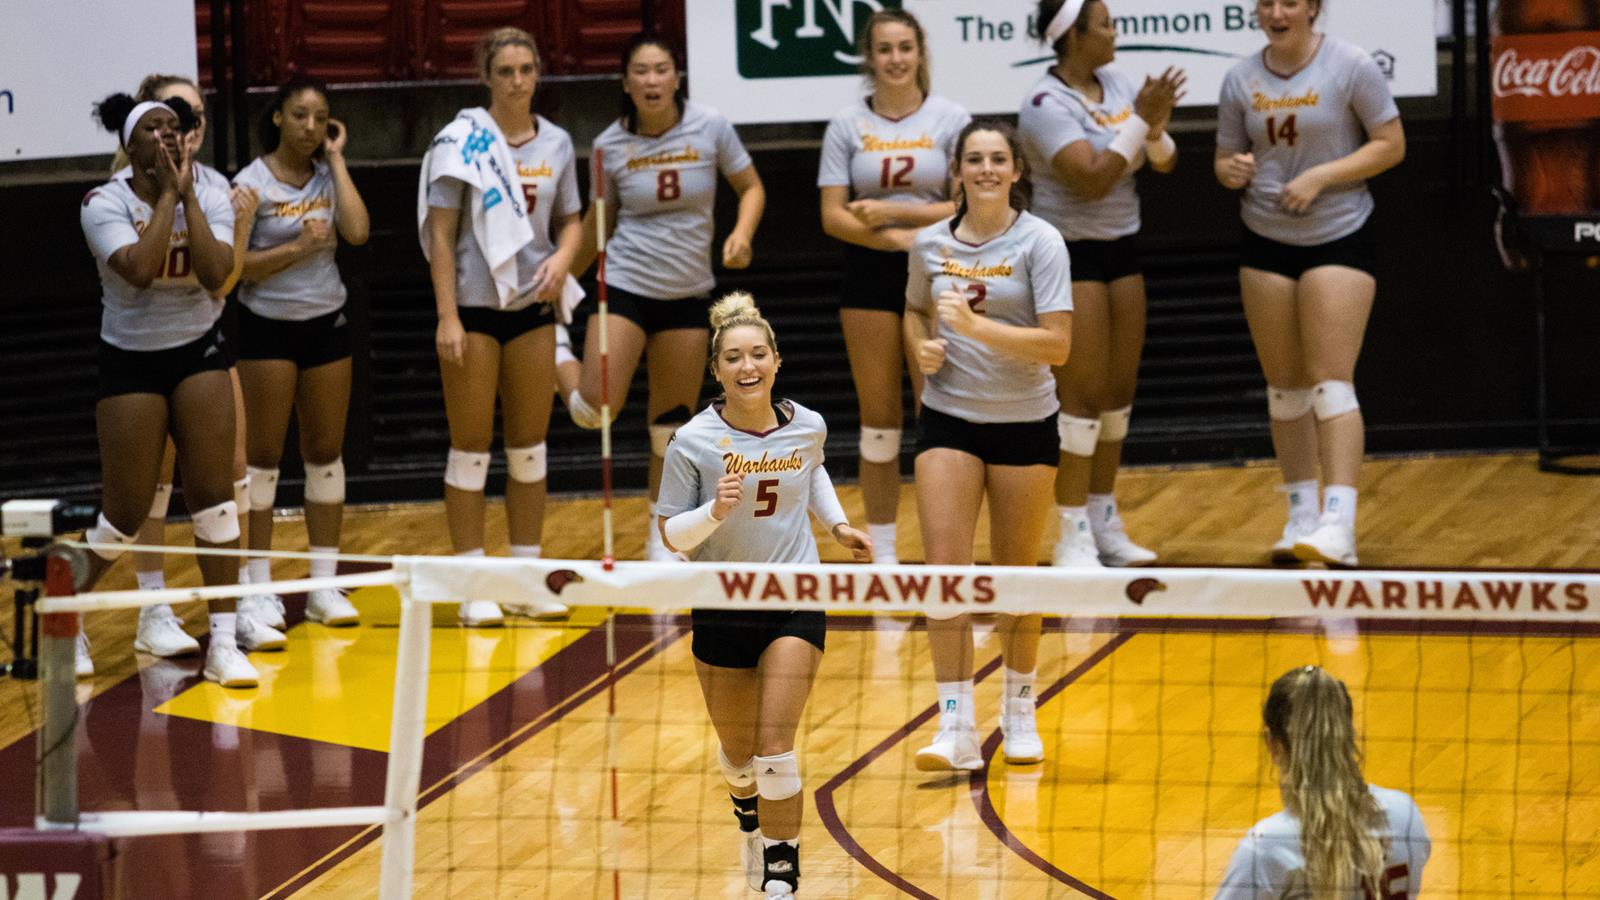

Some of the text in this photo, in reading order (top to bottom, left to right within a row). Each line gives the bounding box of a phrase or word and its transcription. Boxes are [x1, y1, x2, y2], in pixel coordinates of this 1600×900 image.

[955, 16, 1013, 41] The
[1492, 46, 1600, 97] Coca-Col
[1266, 114, 1298, 146] 14
[657, 169, 680, 201] 8
[881, 156, 914, 188] 12
[942, 257, 1013, 278] Warhawks
[967, 284, 986, 314] 2
[723, 448, 802, 475] Warhawks
[754, 479, 779, 517] 5
[718, 571, 996, 604] WARHAWKS
[1301, 579, 1590, 612] WARHAWKS
